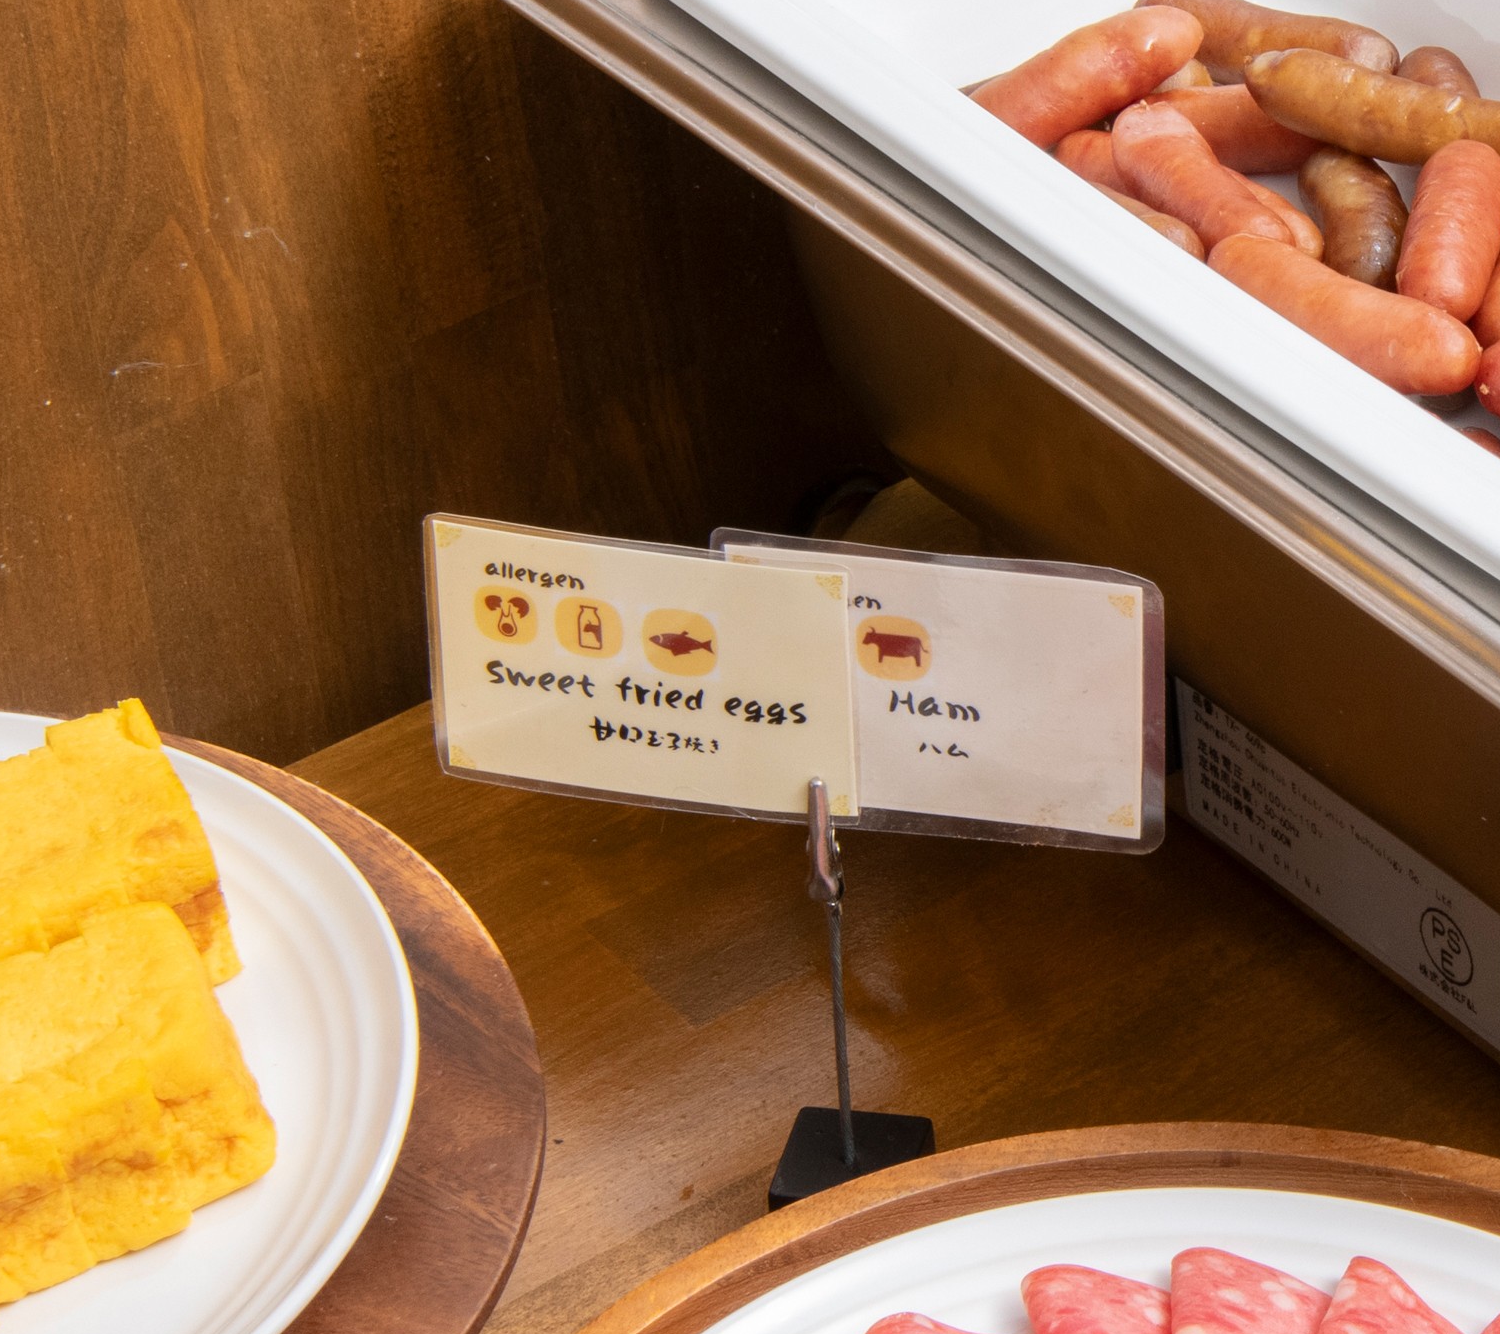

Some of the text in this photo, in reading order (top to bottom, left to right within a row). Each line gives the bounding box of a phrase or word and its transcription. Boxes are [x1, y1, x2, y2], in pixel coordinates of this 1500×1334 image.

[483, 561, 586, 591] allergen
[614, 676, 705, 711] fried
[723, 696, 809, 726] eggs
[889, 689, 981, 723] Ham
[588, 716, 721, 755] 甘口玉子焼き
[918, 741, 970, 760] ハム
[1202, 799, 1321, 896] MADE IN CHINA
